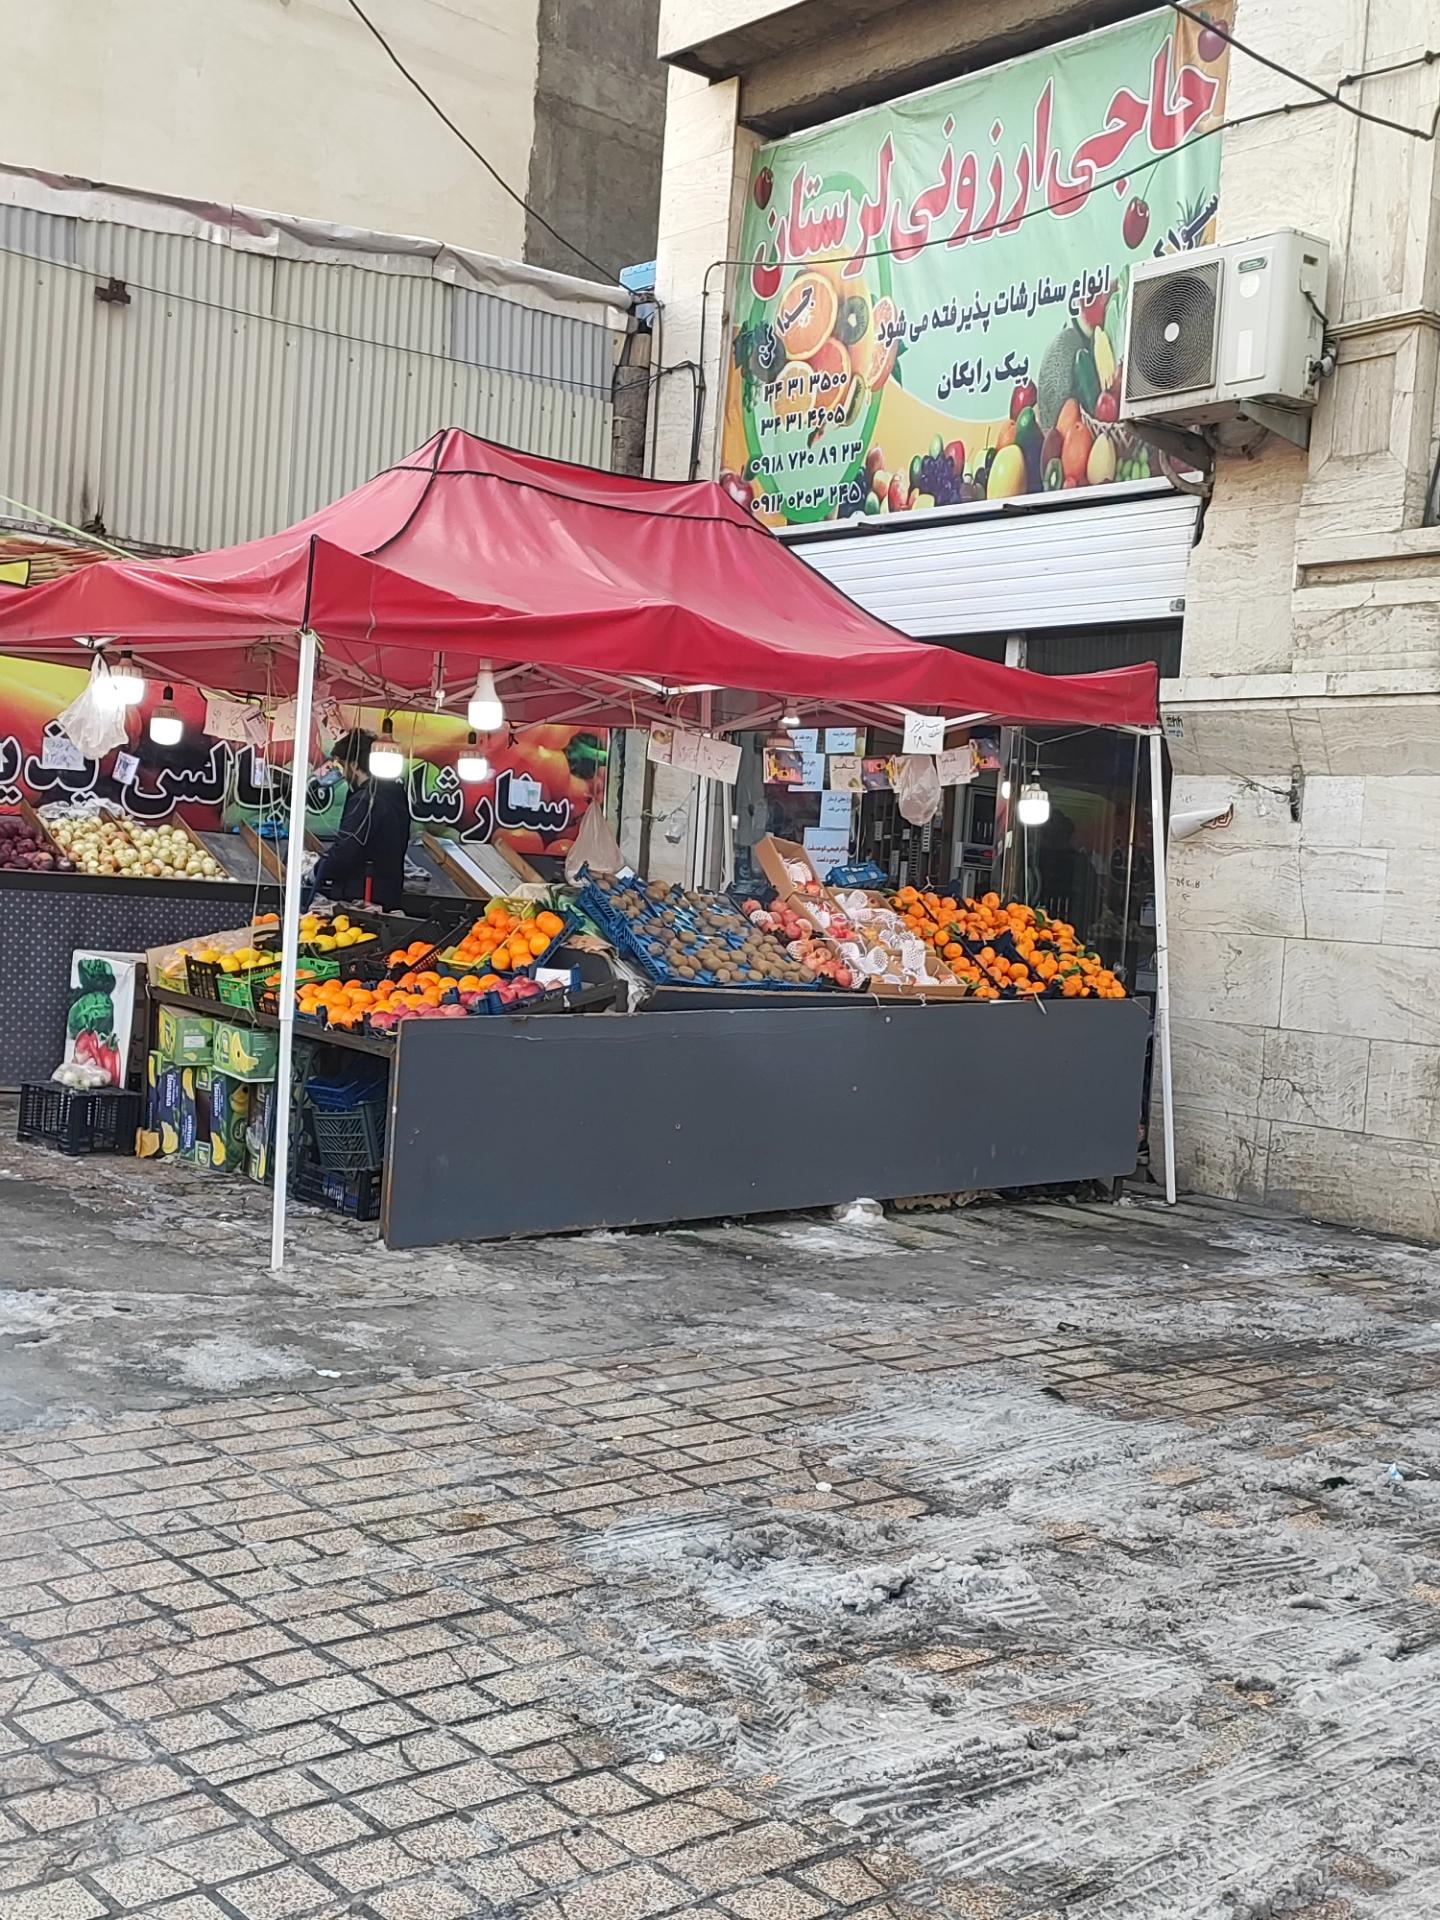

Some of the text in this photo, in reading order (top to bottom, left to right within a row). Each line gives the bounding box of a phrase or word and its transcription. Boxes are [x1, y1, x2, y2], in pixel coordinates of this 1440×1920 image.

[752, 34, 1219, 300] حاجی ارزونی لرستان
[877, 265, 1110, 348] انواع سفارشات پذیرفته می شود
[788, 377, 803, 397] ۳۱
[809, 373, 848, 393] ۳۵۰۰
[937, 351, 1029, 400] پیک رایگان
[786, 412, 802, 432] ۳۱
[808, 406, 845, 428] ۴۶۰۵
[752, 454, 784, 474] ۰۹۱۸
[788, 451, 815, 470] ۷۲۰
[818, 446, 837, 466] ۸۹
[752, 493, 783, 512] ۰۹۱۲
